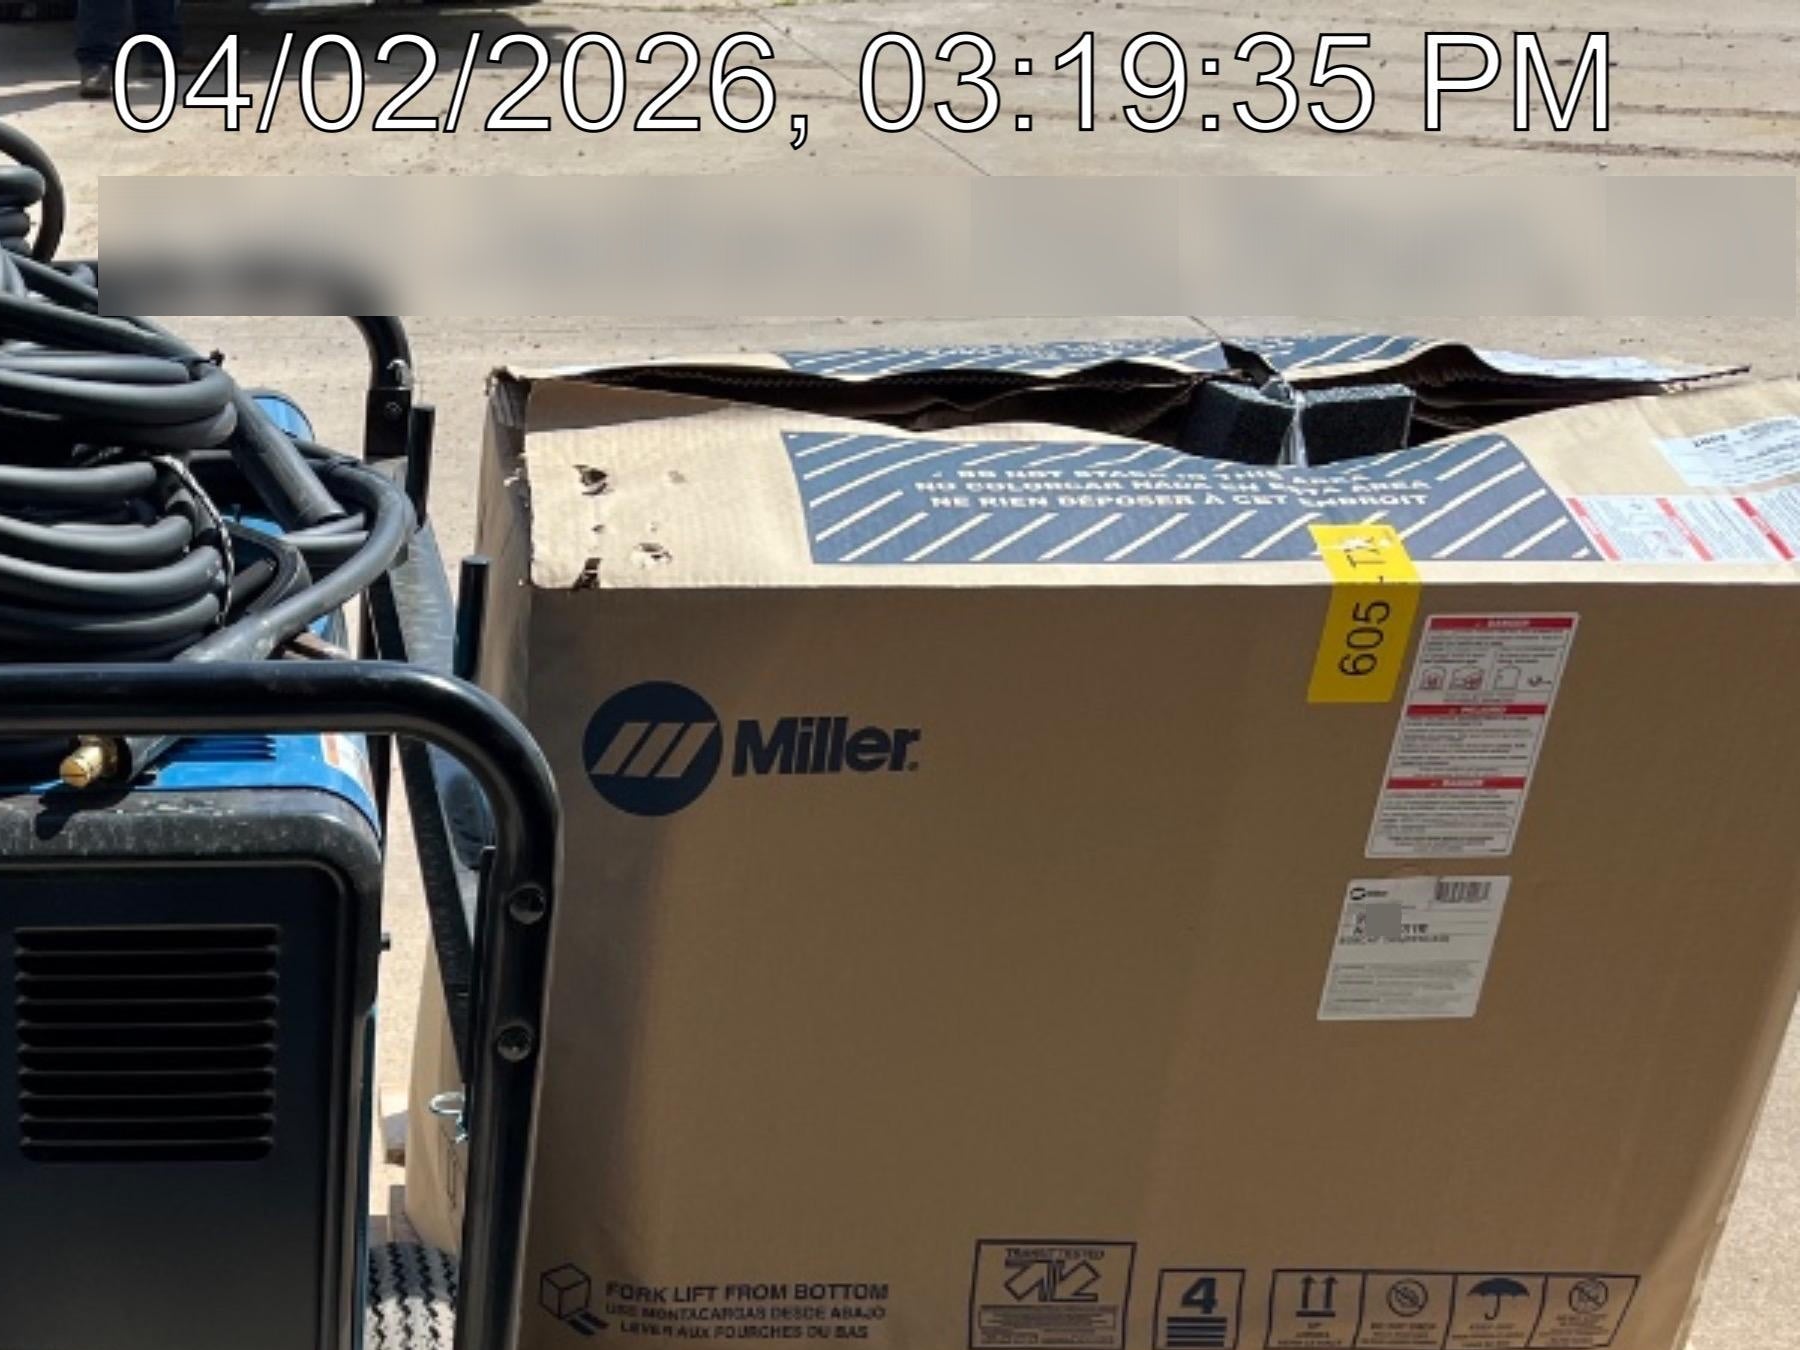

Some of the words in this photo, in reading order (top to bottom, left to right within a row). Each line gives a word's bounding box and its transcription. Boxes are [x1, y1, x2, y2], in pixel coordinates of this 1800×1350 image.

[979, 496, 1050, 509] RIEN
[1232, 494, 1289, 506] CET
[1337, 598, 1392, 678] 605
[605, 1281, 667, 1303] FORK
[673, 1286, 720, 1303] LIFT
[725, 1284, 789, 1301] FROM
[794, 1283, 890, 1301] BOTTOM
[1180, 1276, 1218, 1315] 4
[830, 1305, 886, 1320] ABAJO
